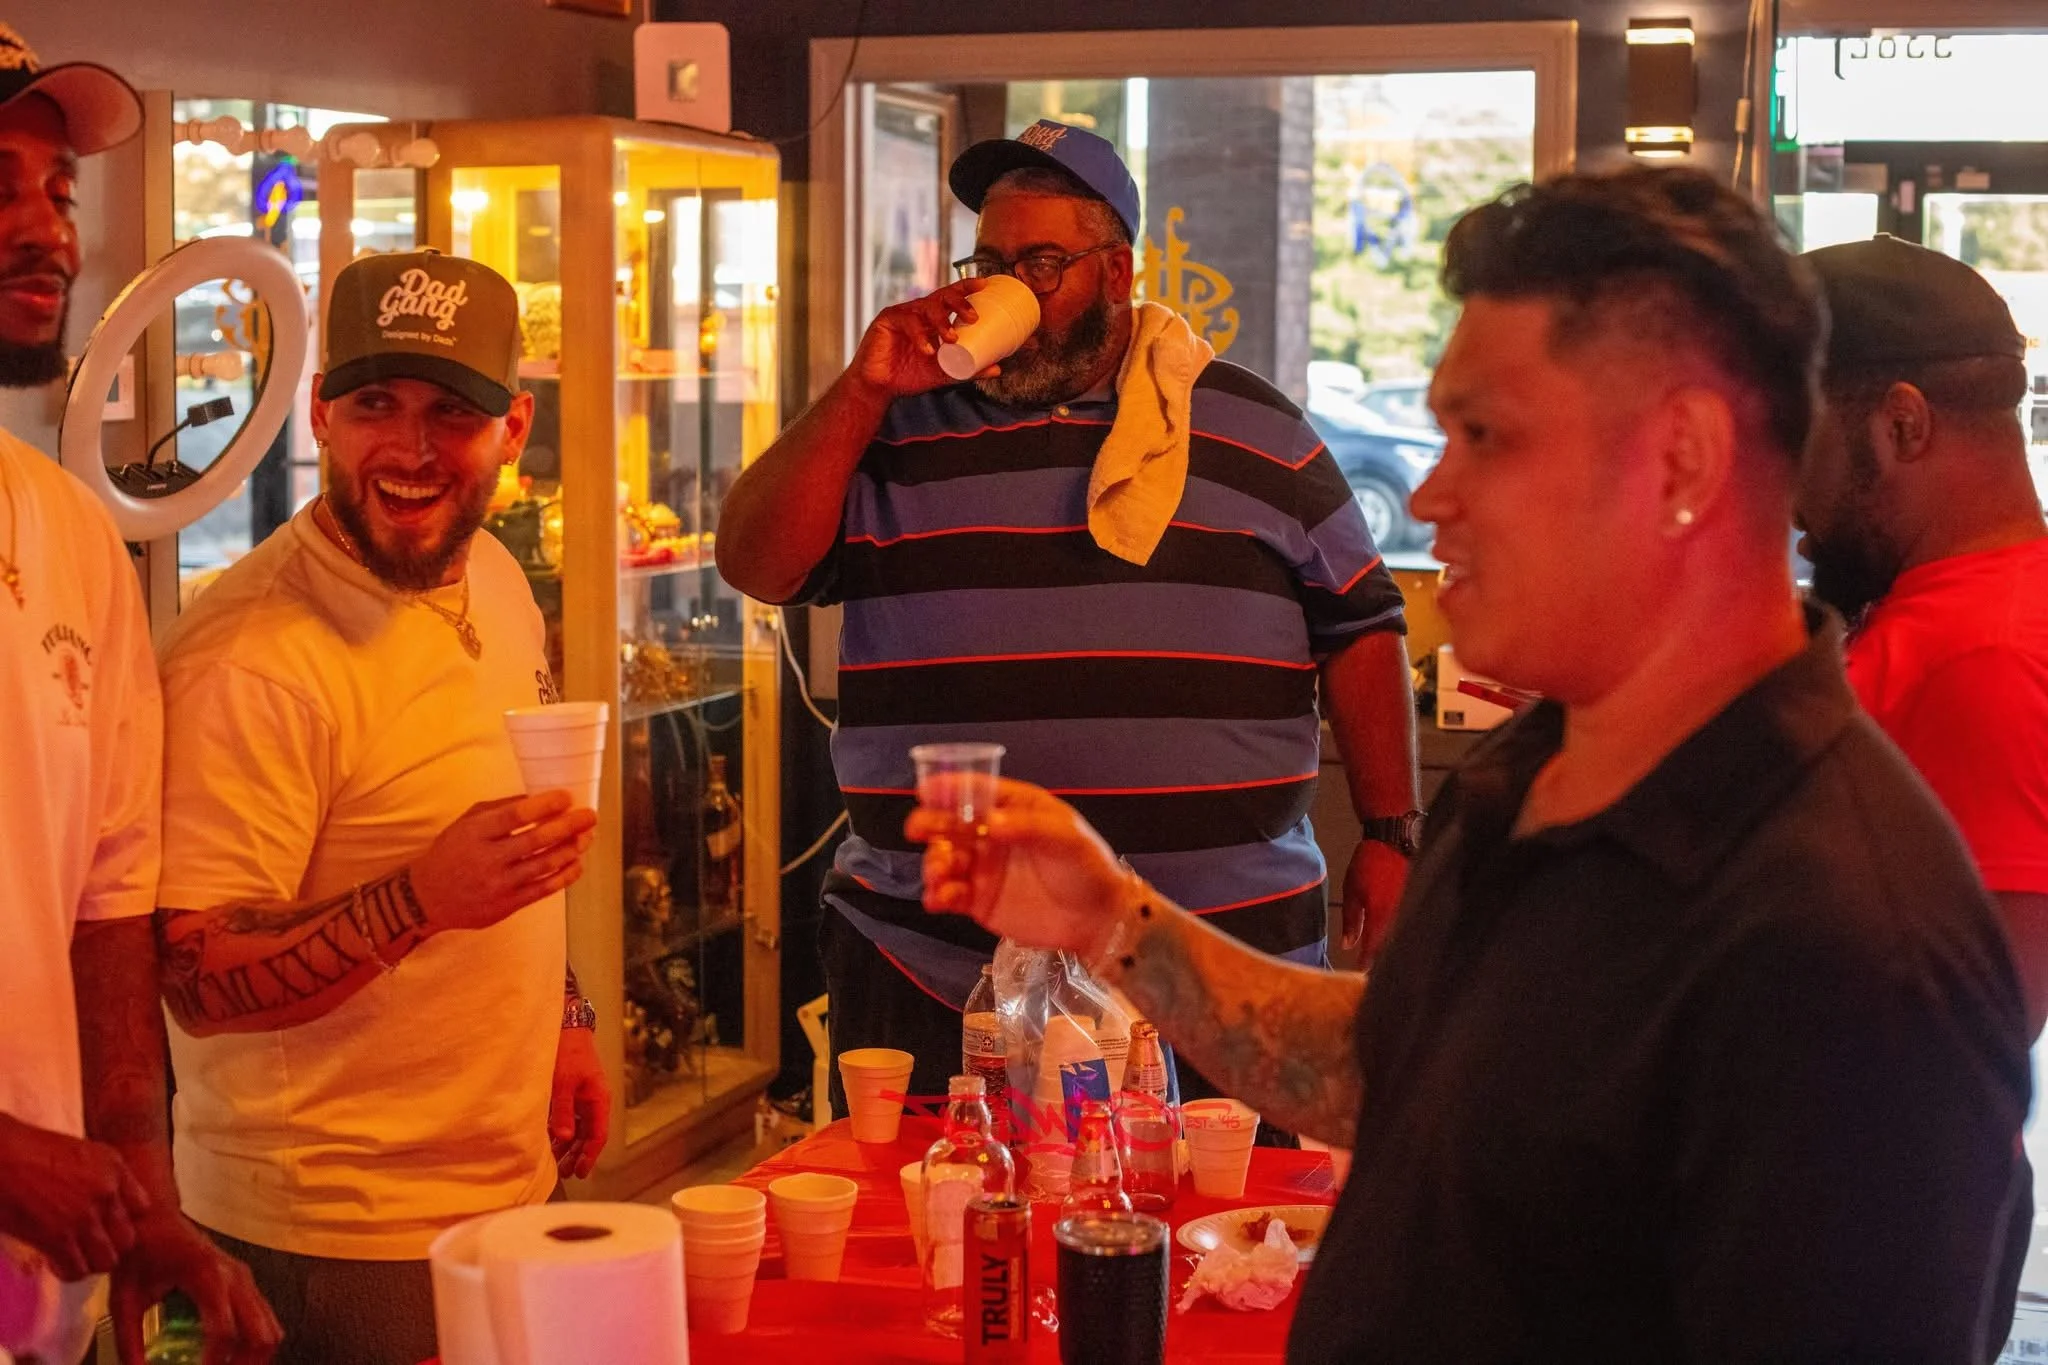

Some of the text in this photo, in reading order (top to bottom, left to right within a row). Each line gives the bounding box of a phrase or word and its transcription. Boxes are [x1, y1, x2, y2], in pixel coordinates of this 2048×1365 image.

[376, 285, 457, 331] Gang
[400, 268, 468, 306] Dad
[981, 1253, 1009, 1346] TRULY
